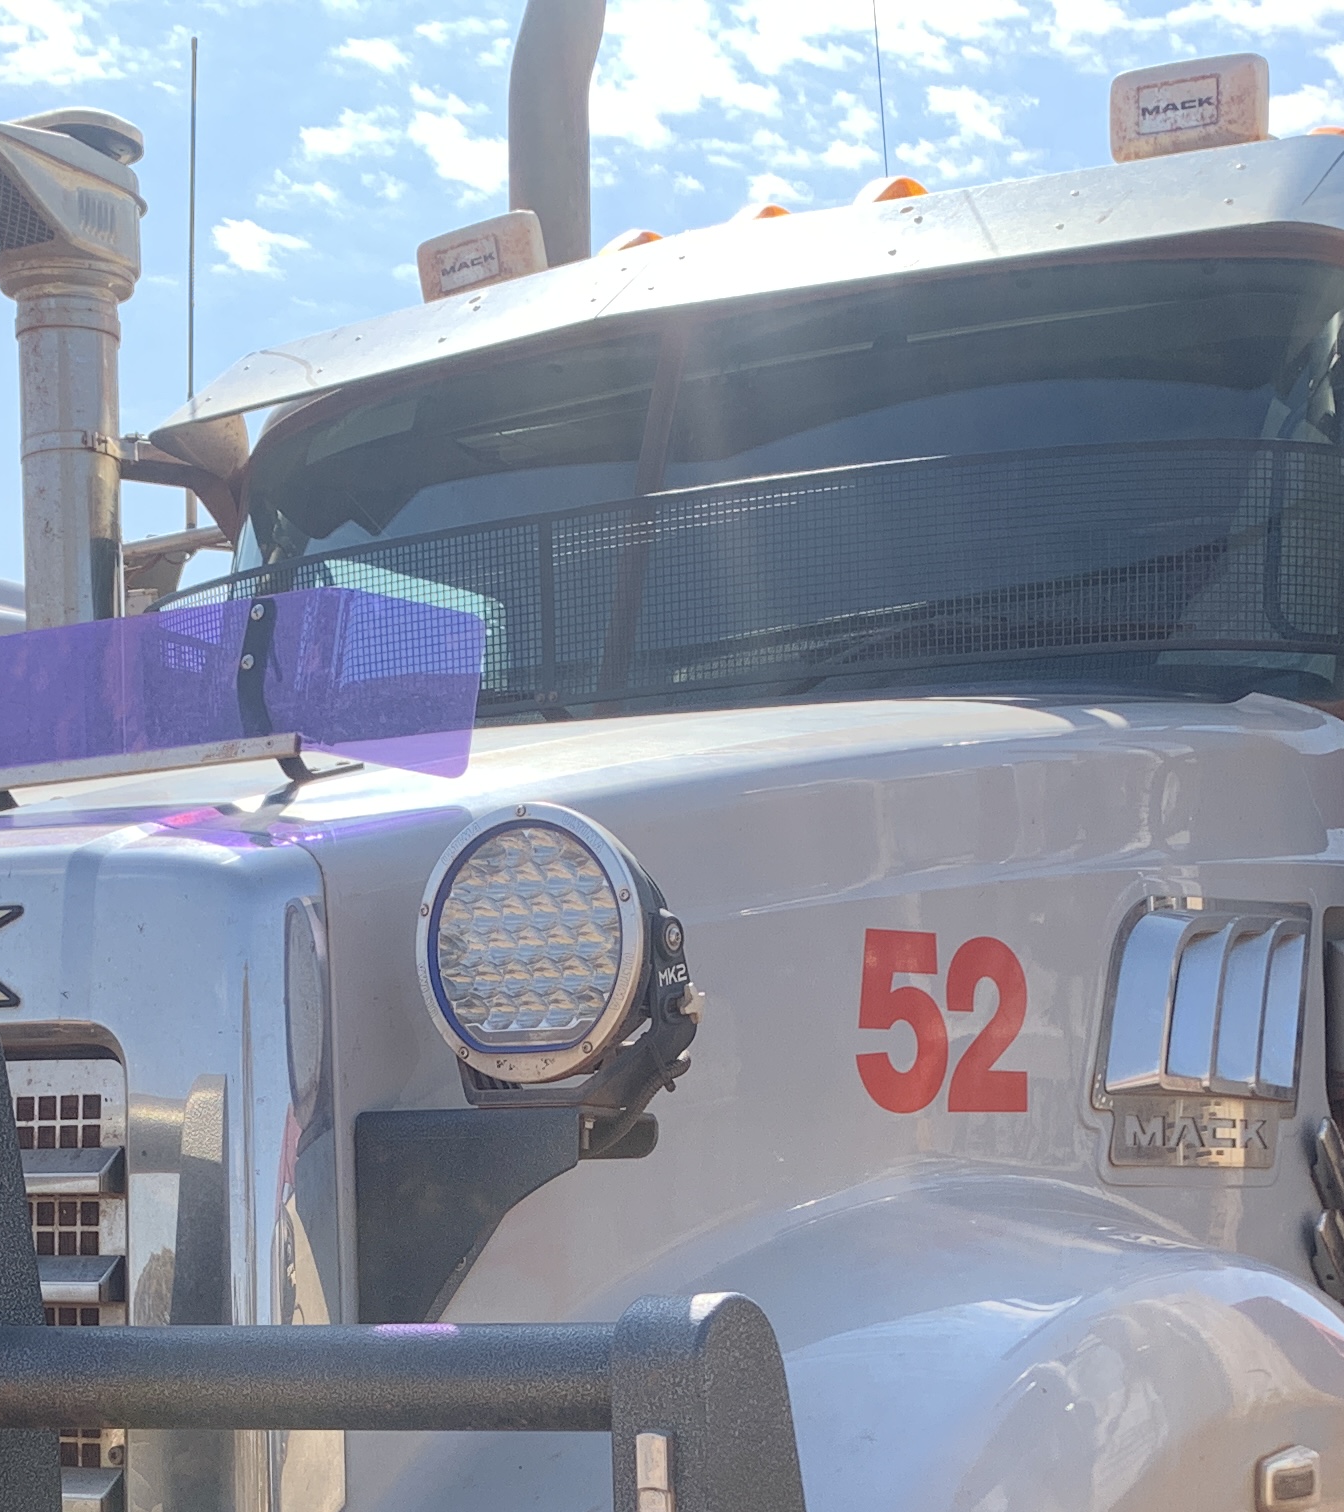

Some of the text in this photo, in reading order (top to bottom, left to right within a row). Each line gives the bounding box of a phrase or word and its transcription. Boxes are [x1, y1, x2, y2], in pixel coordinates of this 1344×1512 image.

[1141, 96, 1214, 119] MACK
[440, 251, 496, 277] MACK
[658, 963, 689, 988] MK2
[855, 927, 1028, 1114] 52
[1124, 1113, 1268, 1150] MACK
